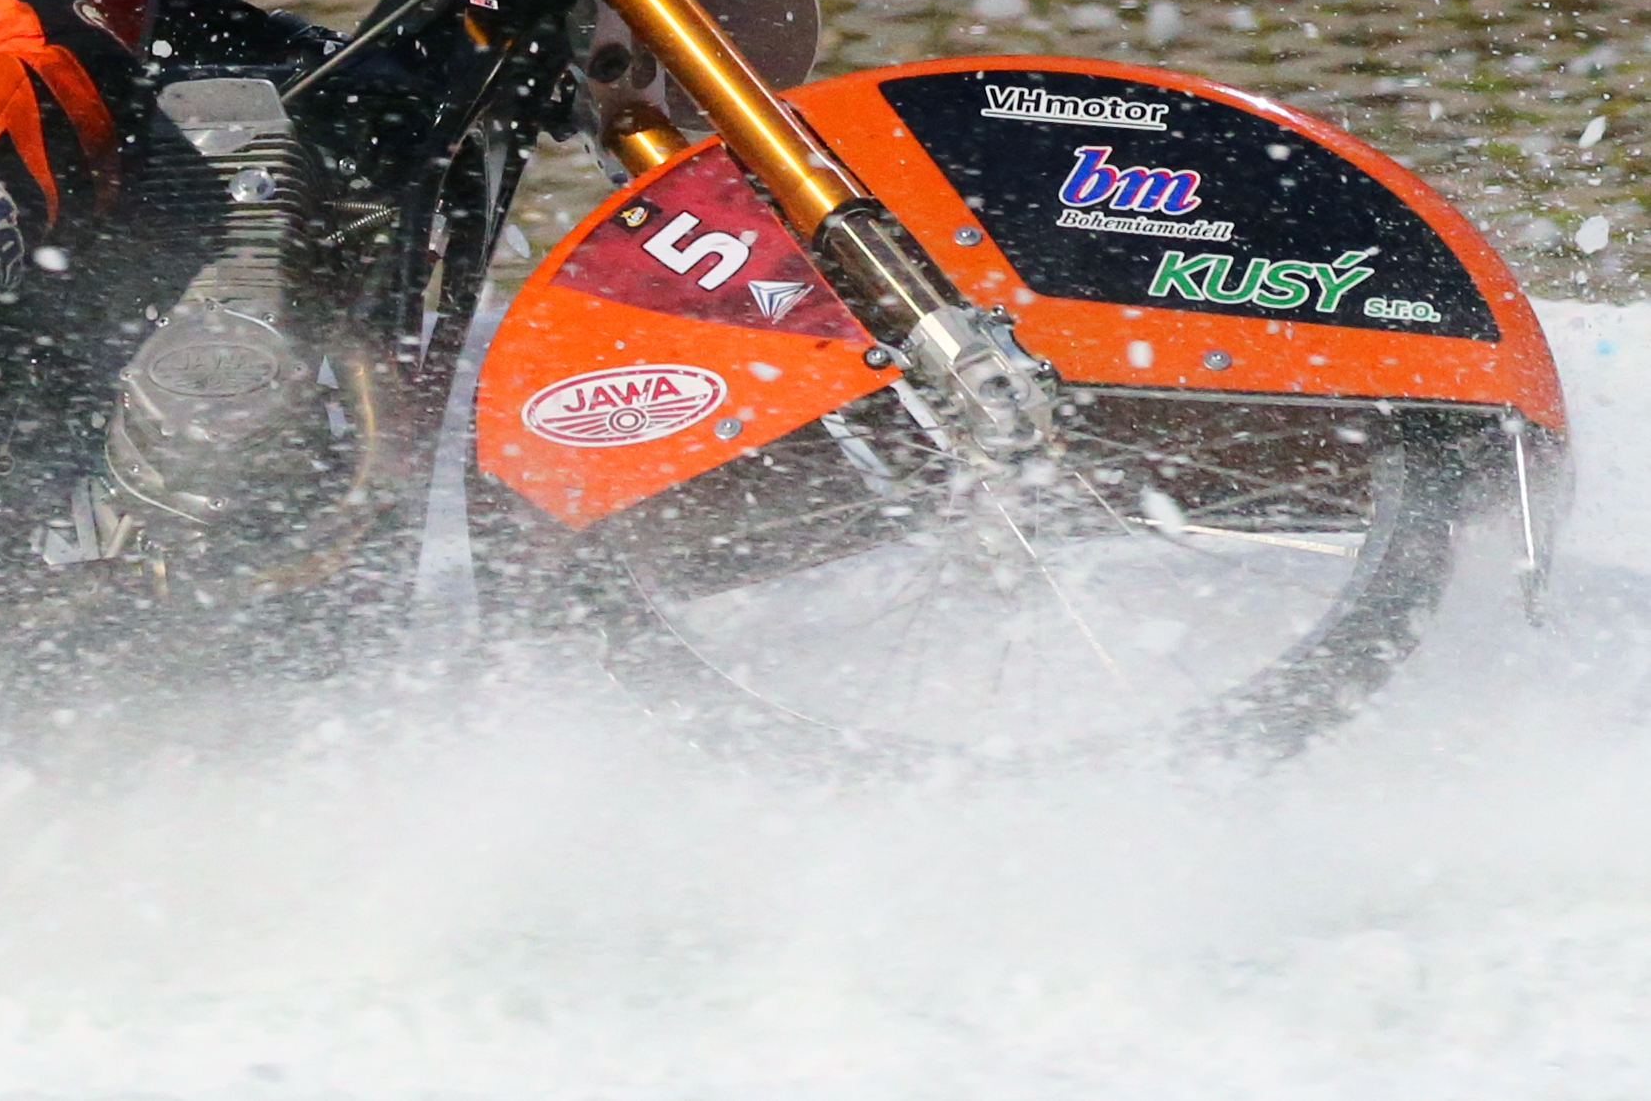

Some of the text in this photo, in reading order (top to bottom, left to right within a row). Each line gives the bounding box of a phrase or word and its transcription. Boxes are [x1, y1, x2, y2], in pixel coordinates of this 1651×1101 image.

[985, 85, 1169, 124] VHmotor
[1059, 146, 1201, 214] bm
[642, 212, 750, 290] 5
[1057, 210, 1234, 241] Bohemiamodell
[1148, 250, 1441, 322] KUSÝ s.r.o.
[563, 376, 682, 413] JAWA
